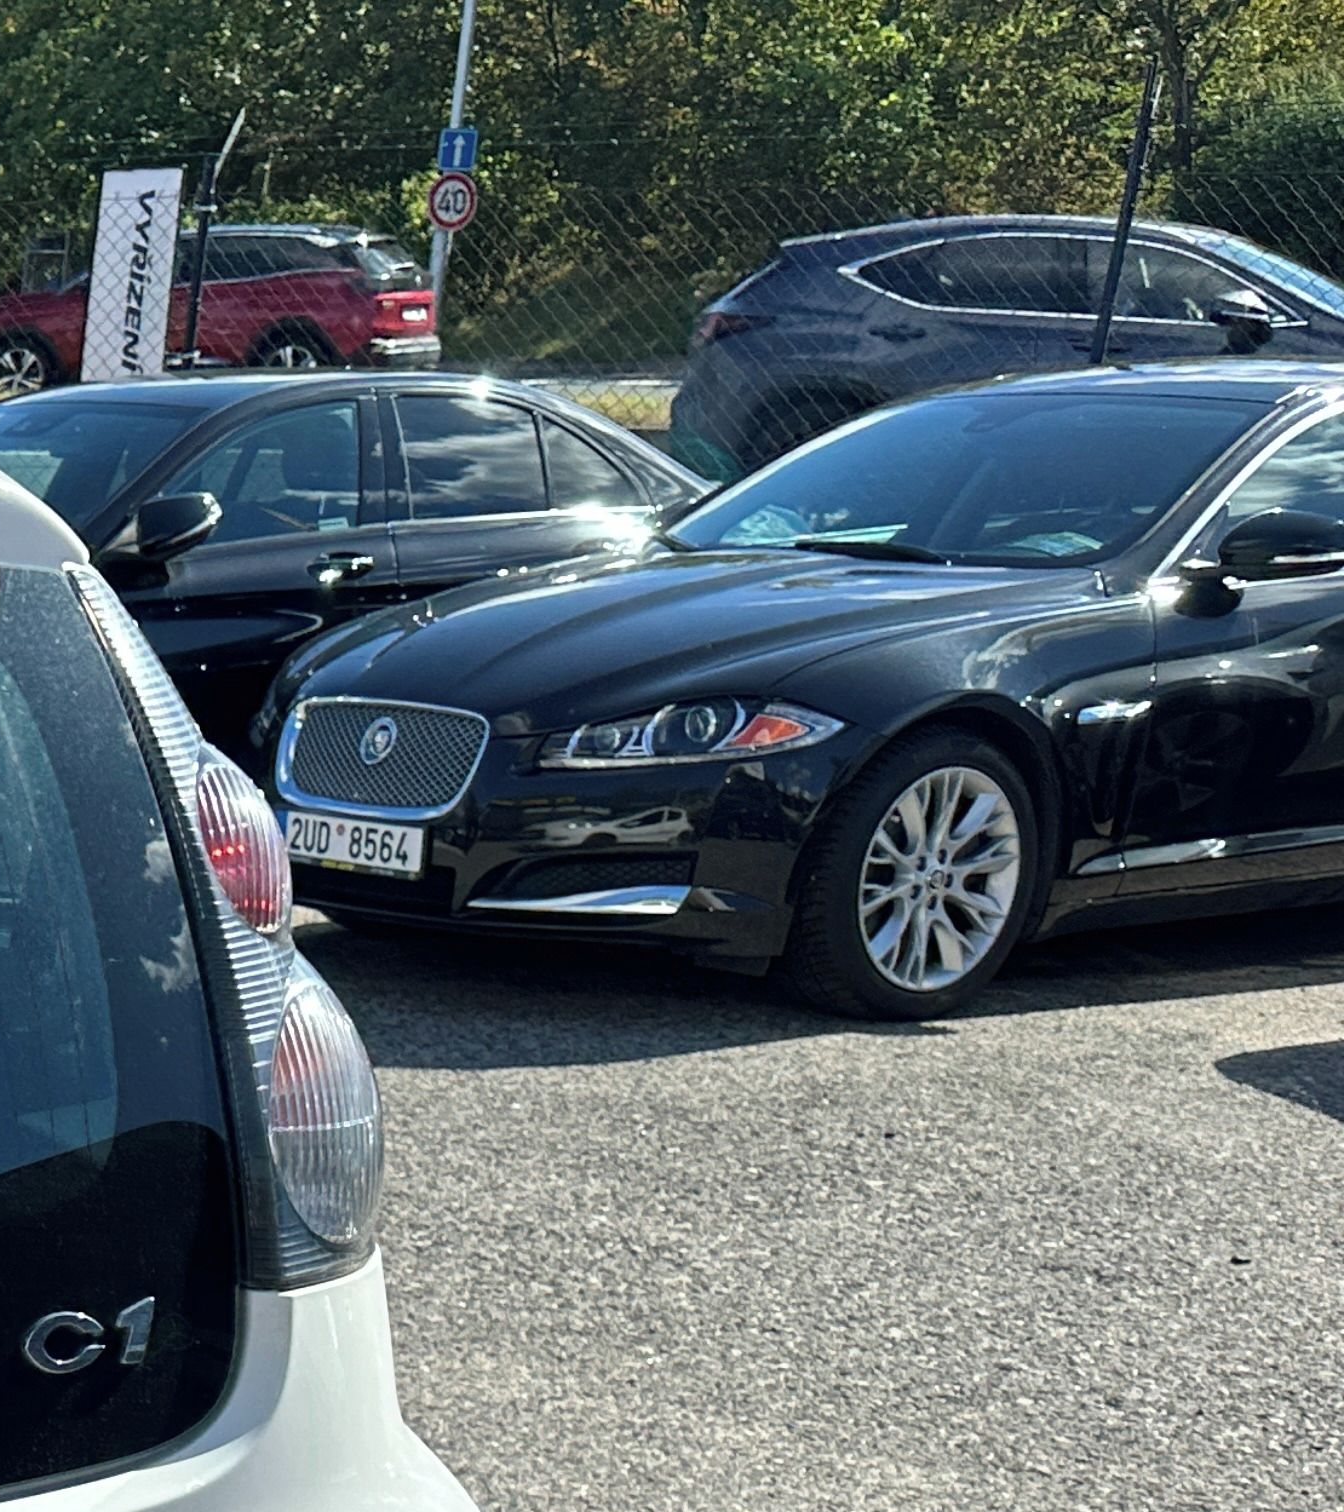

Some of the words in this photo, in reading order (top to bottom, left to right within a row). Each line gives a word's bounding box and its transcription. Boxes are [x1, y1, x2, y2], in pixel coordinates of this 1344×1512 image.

[438, 188, 466, 213] 40
[290, 818, 331, 854] 2UD
[348, 826, 408, 866] 8564
[24, 1296, 155, 1374] C1
